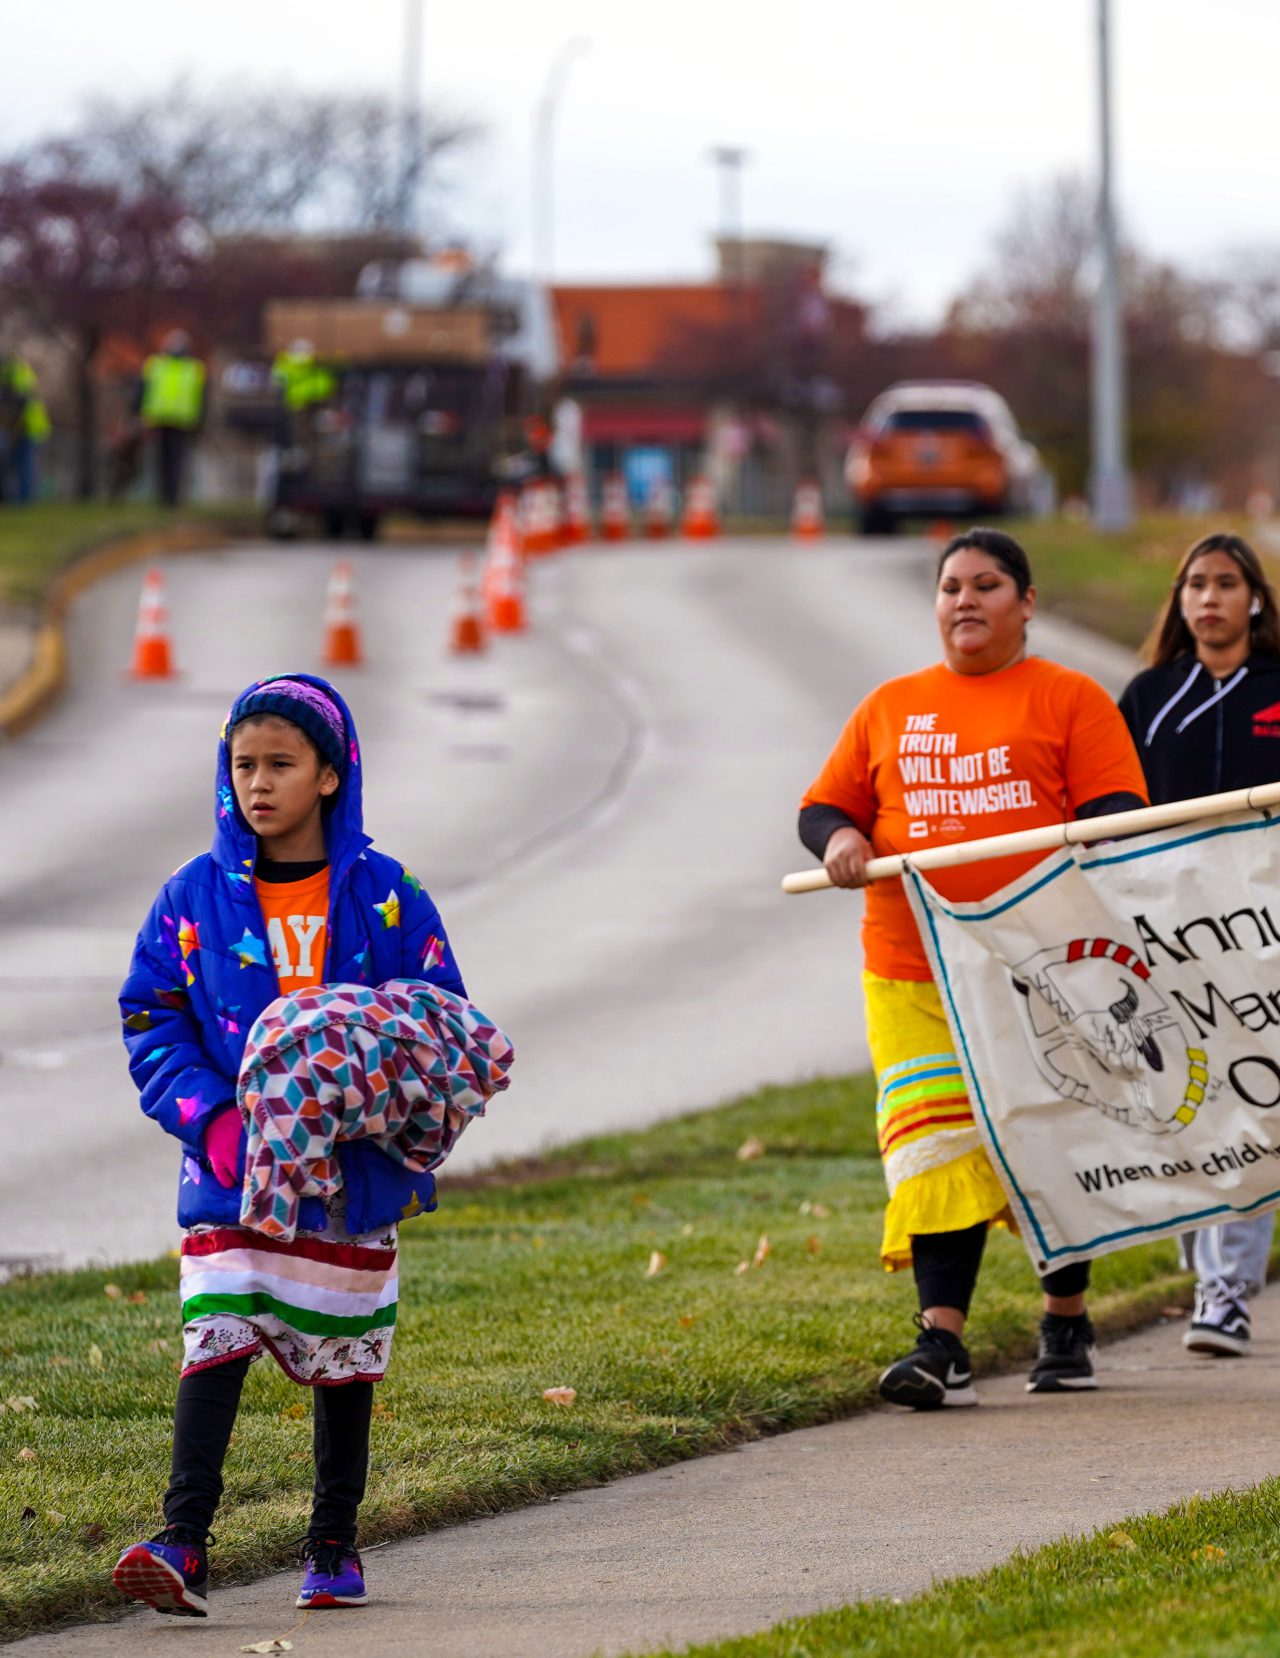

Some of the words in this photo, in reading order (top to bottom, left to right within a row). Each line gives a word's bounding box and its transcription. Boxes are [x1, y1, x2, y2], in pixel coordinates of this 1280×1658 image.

[905, 713, 939, 732] THE
[898, 733, 957, 755] TRUTH
[898, 755, 946, 785] WILL
[949, 752, 984, 784] NOT
[987, 745, 1012, 777] BE
[903, 780, 1037, 817] WHITEWASHED.
[1075, 1164, 1156, 1194] When
[1160, 1158, 1196, 1178] ou
